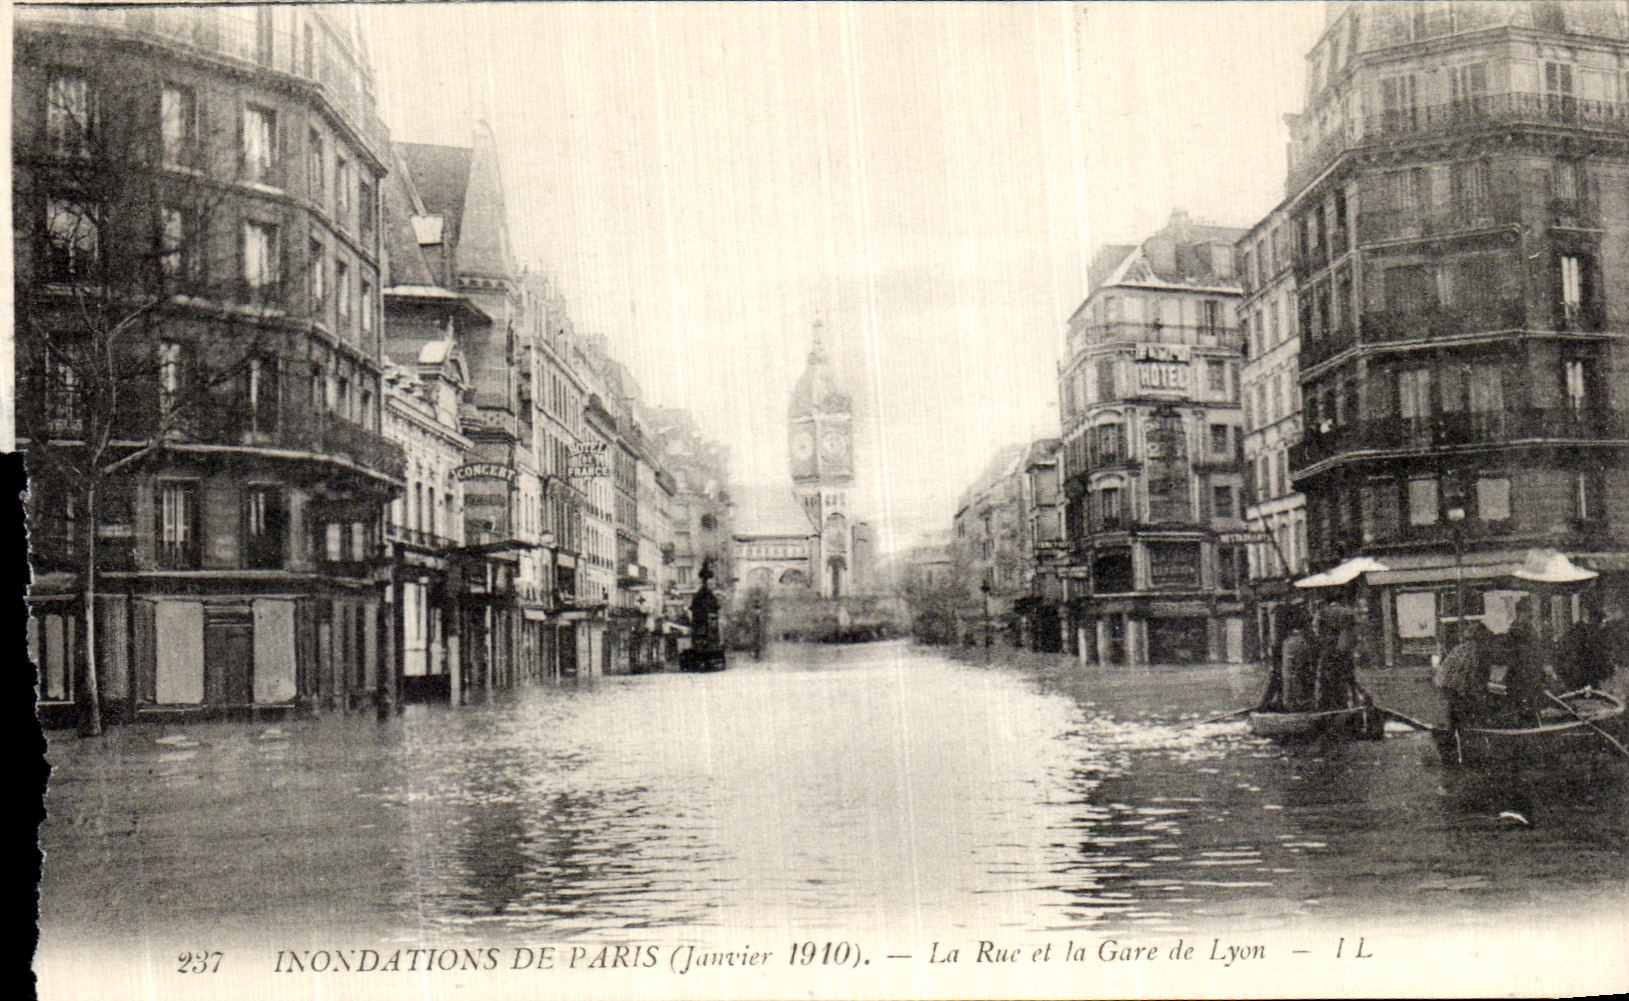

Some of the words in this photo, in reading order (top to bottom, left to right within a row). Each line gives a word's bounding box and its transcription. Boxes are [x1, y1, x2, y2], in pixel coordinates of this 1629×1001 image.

[1139, 364, 1186, 387] HOTEL
[569, 440, 606, 456] HOTEL
[457, 464, 516, 481] CONCERT
[568, 466, 609, 477] FRANCE
